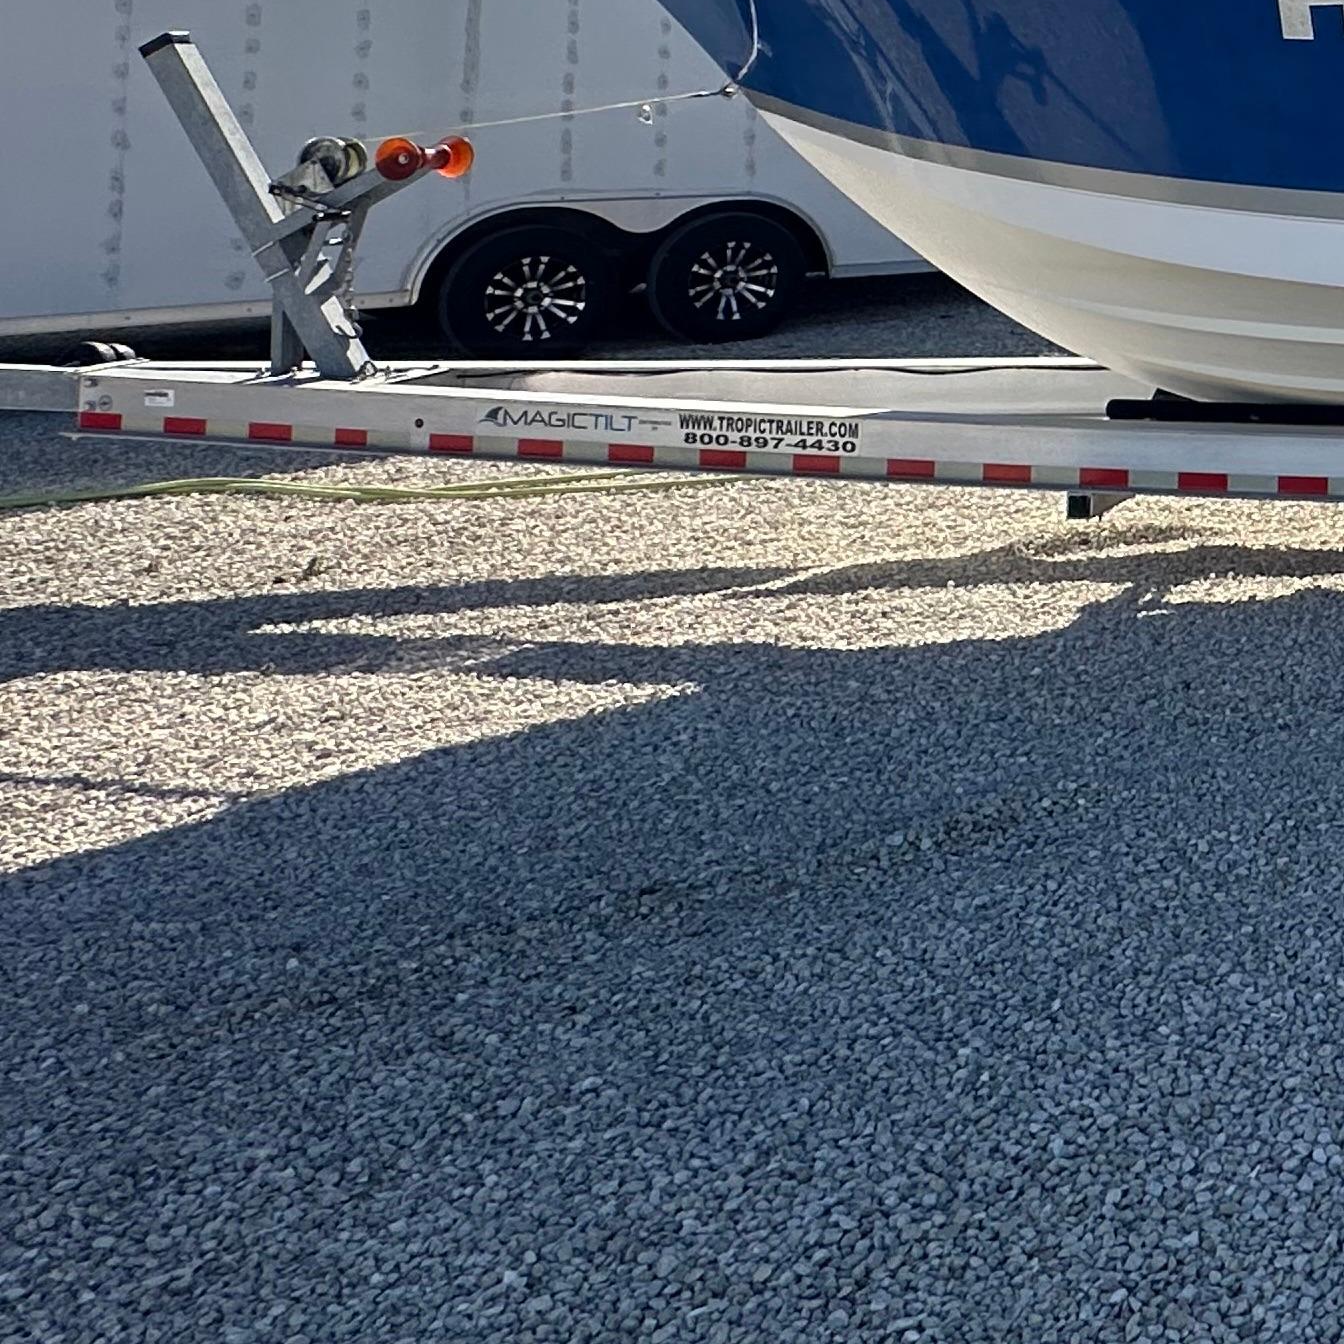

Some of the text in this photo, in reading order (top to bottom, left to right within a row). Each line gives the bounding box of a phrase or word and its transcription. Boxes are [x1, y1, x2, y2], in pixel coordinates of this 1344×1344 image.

[502, 408, 638, 432] MAGICTILT
[679, 413, 859, 440] WWW.TROPICTRAILER.COM
[683, 431, 857, 454] 800-897-4430
